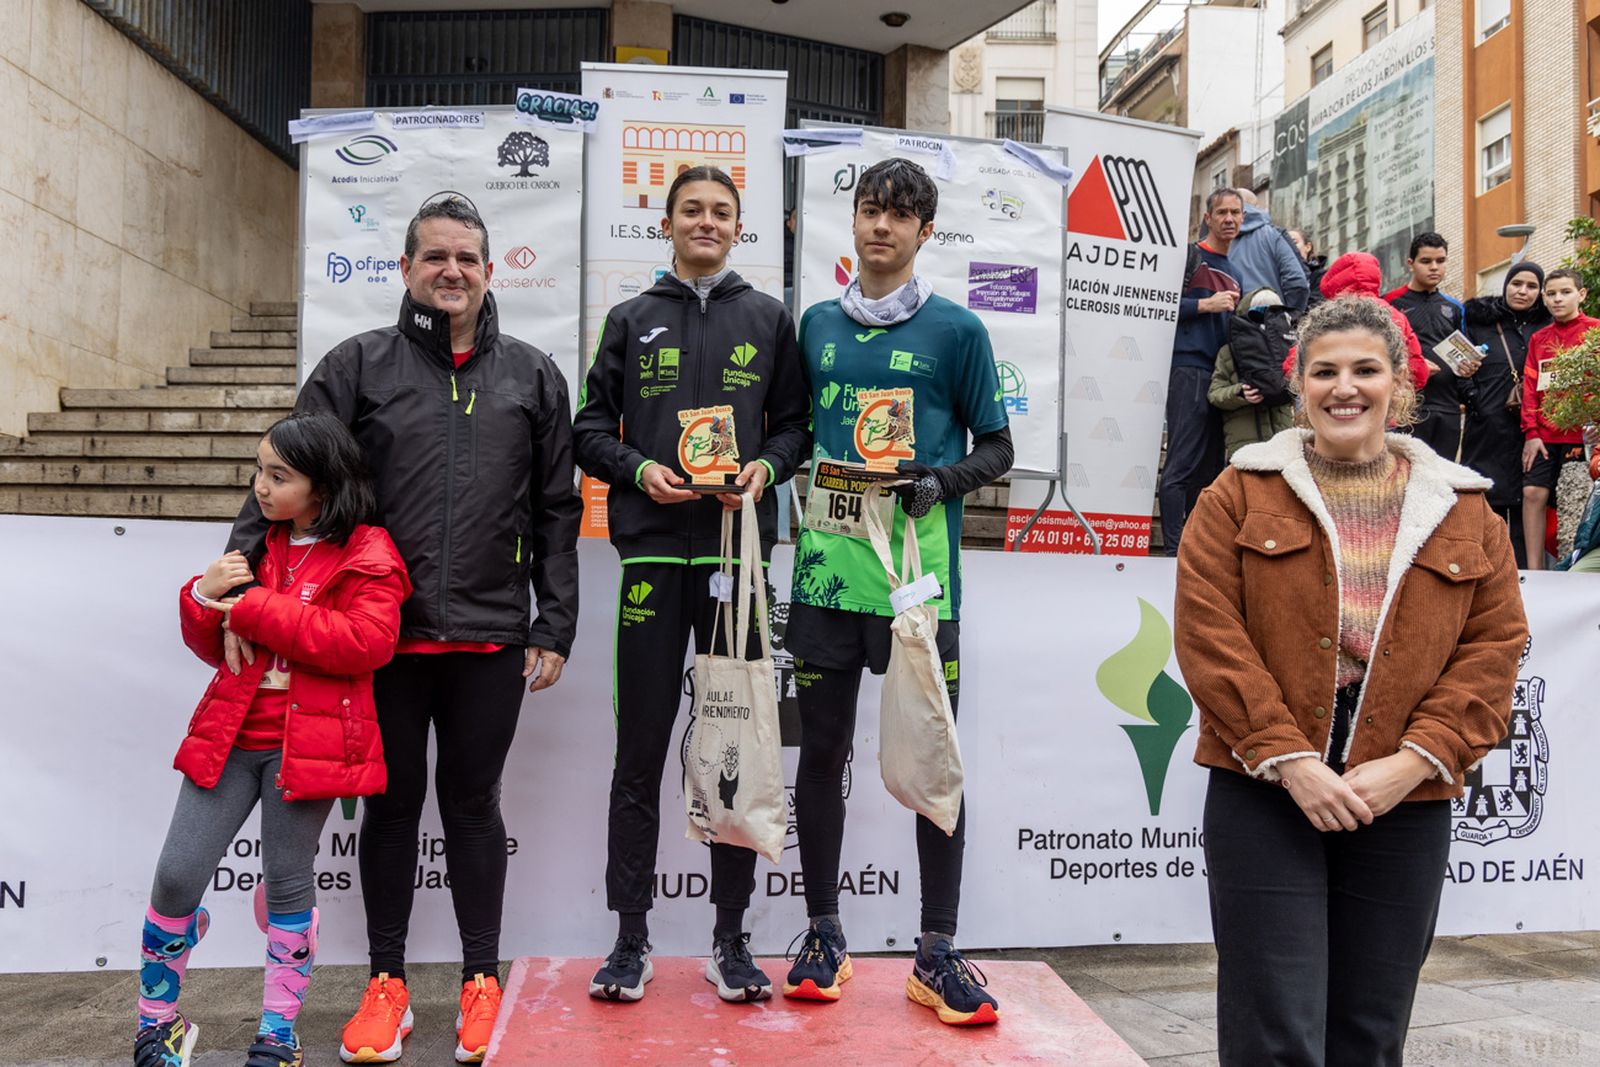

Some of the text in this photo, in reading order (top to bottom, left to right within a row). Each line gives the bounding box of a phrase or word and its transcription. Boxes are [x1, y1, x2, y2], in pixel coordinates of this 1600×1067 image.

[517, 92, 599, 121] GRACIAS!
[395, 115, 480, 125] PATROCINADORES
[899, 138, 943, 151] PATROCIN
[331, 175, 399, 184] Acodis Iniciativas
[516, 181, 529, 190] DEL
[530, 179, 561, 190] CARBÓN
[610, 225, 645, 239] I.E.S.
[932, 231, 974, 245] ngenia
[1067, 242, 1158, 272] AJDEM
[1066, 279, 1179, 304] IACIÓN JIENNENSE
[1066, 297, 1177, 322] CLEROSIS MÚLTIPLE
[414, 313, 432, 330] HH
[723, 368, 761, 382] Fundación
[723, 376, 751, 387] Unicaja
[860, 392, 868, 400] IES
[881, 390, 894, 398] Juan
[690, 409, 700, 417] San
[700, 408, 715, 416] Juan
[715, 405, 731, 413] Bosco
[820, 464, 840, 475] IES San
[822, 475, 848, 490] CARRERA
[828, 492, 862, 523] 164
[1032, 529, 1045, 544] 74
[1047, 530, 1059, 545] 01
[1062, 531, 1074, 545] 91
[1083, 532, 1103, 546] 65
[1105, 533, 1119, 548] 25
[1121, 534, 1134, 548] 09
[1136, 535, 1150, 549] 89
[623, 605, 656, 616] Fundación
[623, 614, 645, 623] Unicaja
[1018, 828, 1133, 850] Patronato
[1460, 830, 1489, 841] GUARDA
[1050, 858, 1158, 885] Deportes
[1166, 856, 1195, 878] de
[1483, 860, 1515, 882] DE
[1521, 852, 1583, 881] JAÉN
[837, 863, 900, 895] AÉN
